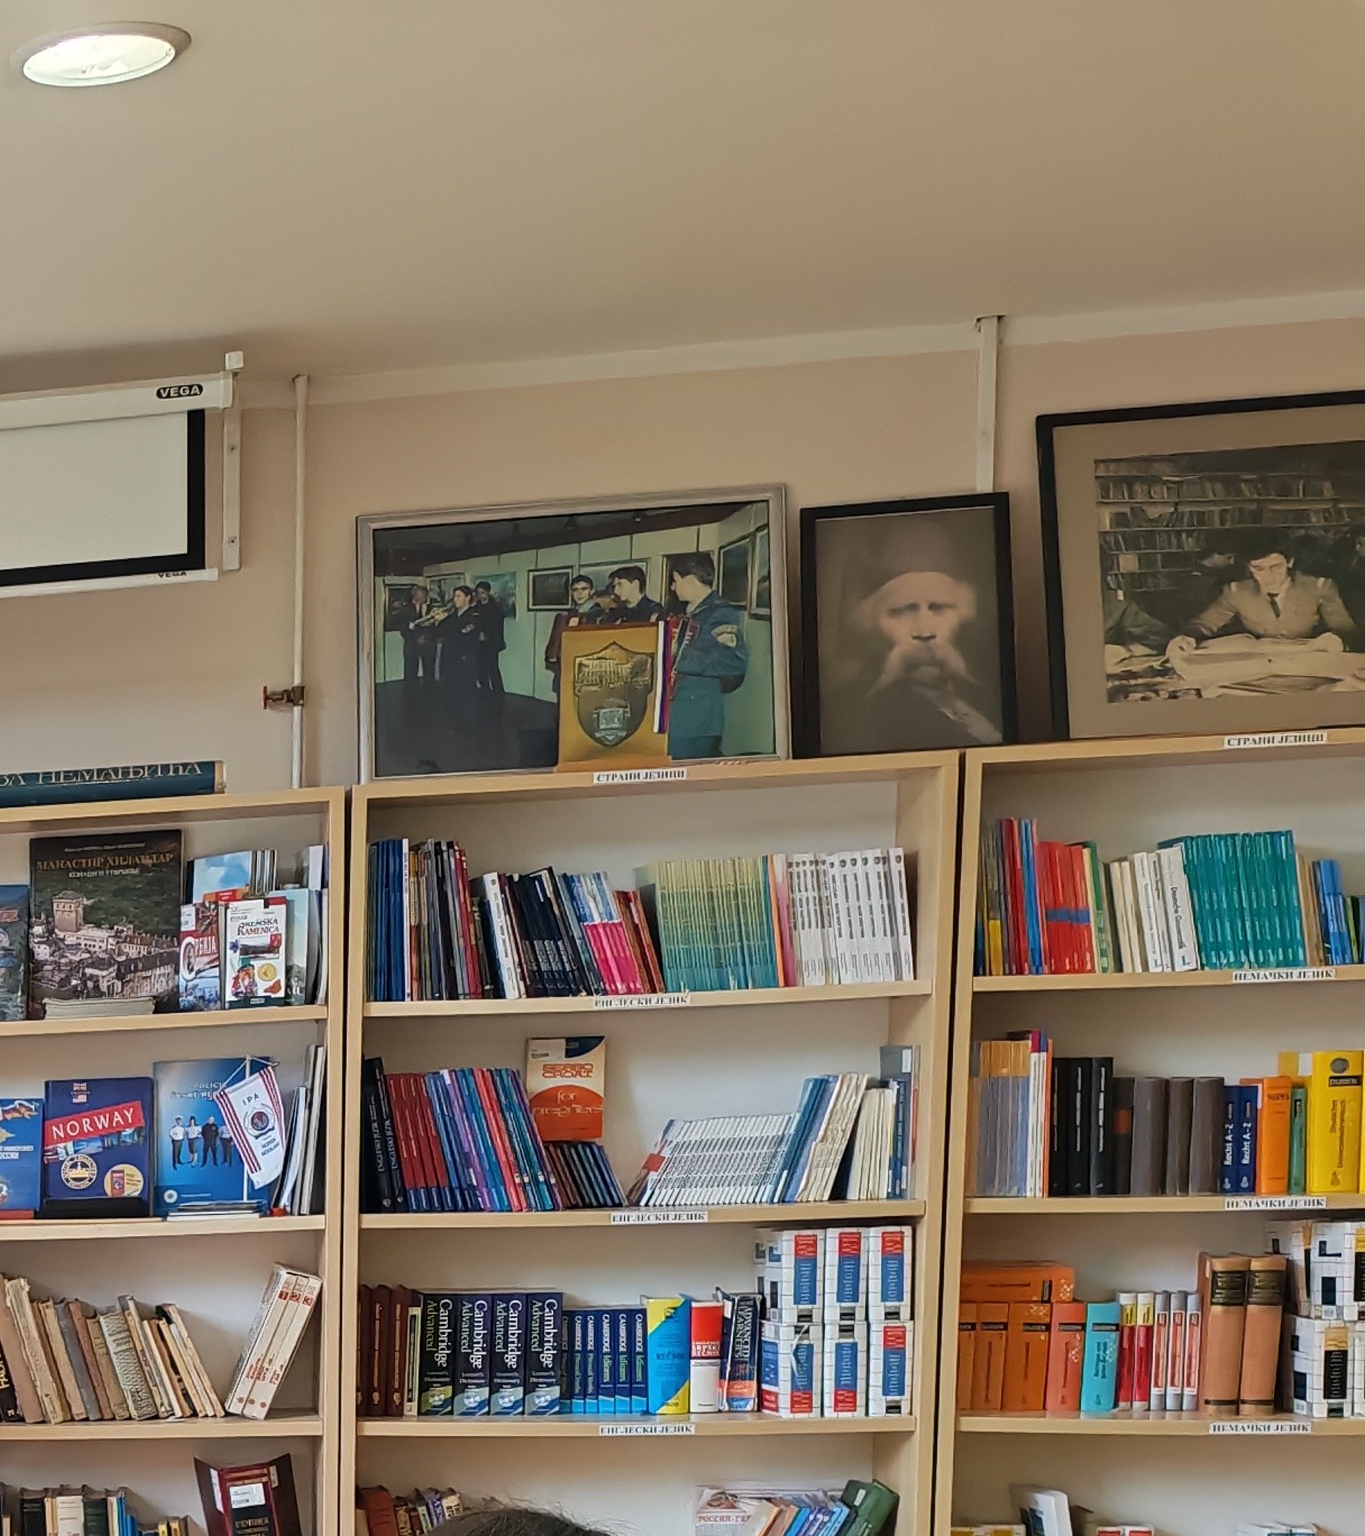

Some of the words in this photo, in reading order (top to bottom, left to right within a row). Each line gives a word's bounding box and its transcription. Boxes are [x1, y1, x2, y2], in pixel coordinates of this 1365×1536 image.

[159, 384, 201, 398] VEGA
[36, 762, 203, 785] НЕМАЊИЋА
[37, 858, 104, 870] МАНАСТИР
[237, 925, 280, 936] KAMENICA
[1233, 970, 1293, 981] НЕМАЧКИ
[1296, 969, 1334, 979] ЈЕЗИК
[593, 997, 652, 1008] ЕНГЛЕСКИ
[655, 996, 688, 1006] ЈЕЗИК
[242, 1092, 260, 1105] IPA
[557, 1090, 578, 1104] for
[51, 1107, 135, 1140] NORWAY
[1226, 1198, 1286, 1209] НЕМАЧКИ
[1287, 1197, 1325, 1208] ЈЕЗИК
[612, 1213, 669, 1224] ЕНГЛЕСКИ
[672, 1212, 705, 1222] ЈЕЗИК
[425, 1300, 437, 1352] Advanced
[434, 1299, 453, 1367] Cambridge
[460, 1301, 472, 1353] Advanced
[470, 1300, 488, 1369] Cambridge
[495, 1300, 507, 1352] Advanced
[504, 1300, 522, 1369] Cambridge
[531, 1300, 542, 1352] Advanced
[539, 1299, 558, 1368] Cambridge
[602, 1314, 610, 1353] CAMBRIDGE
[619, 1314, 627, 1353] CAMBRIDGE
[635, 1314, 643, 1352] CAMBRIDGE
[600, 1425, 658, 1435] ЕНГЛЕСКИ
[659, 1424, 692, 1434] ЈЕЗИК
[1212, 1423, 1272, 1433] НЕМАЧКИ
[1273, 1423, 1310, 1432] ЈЕЗИК
